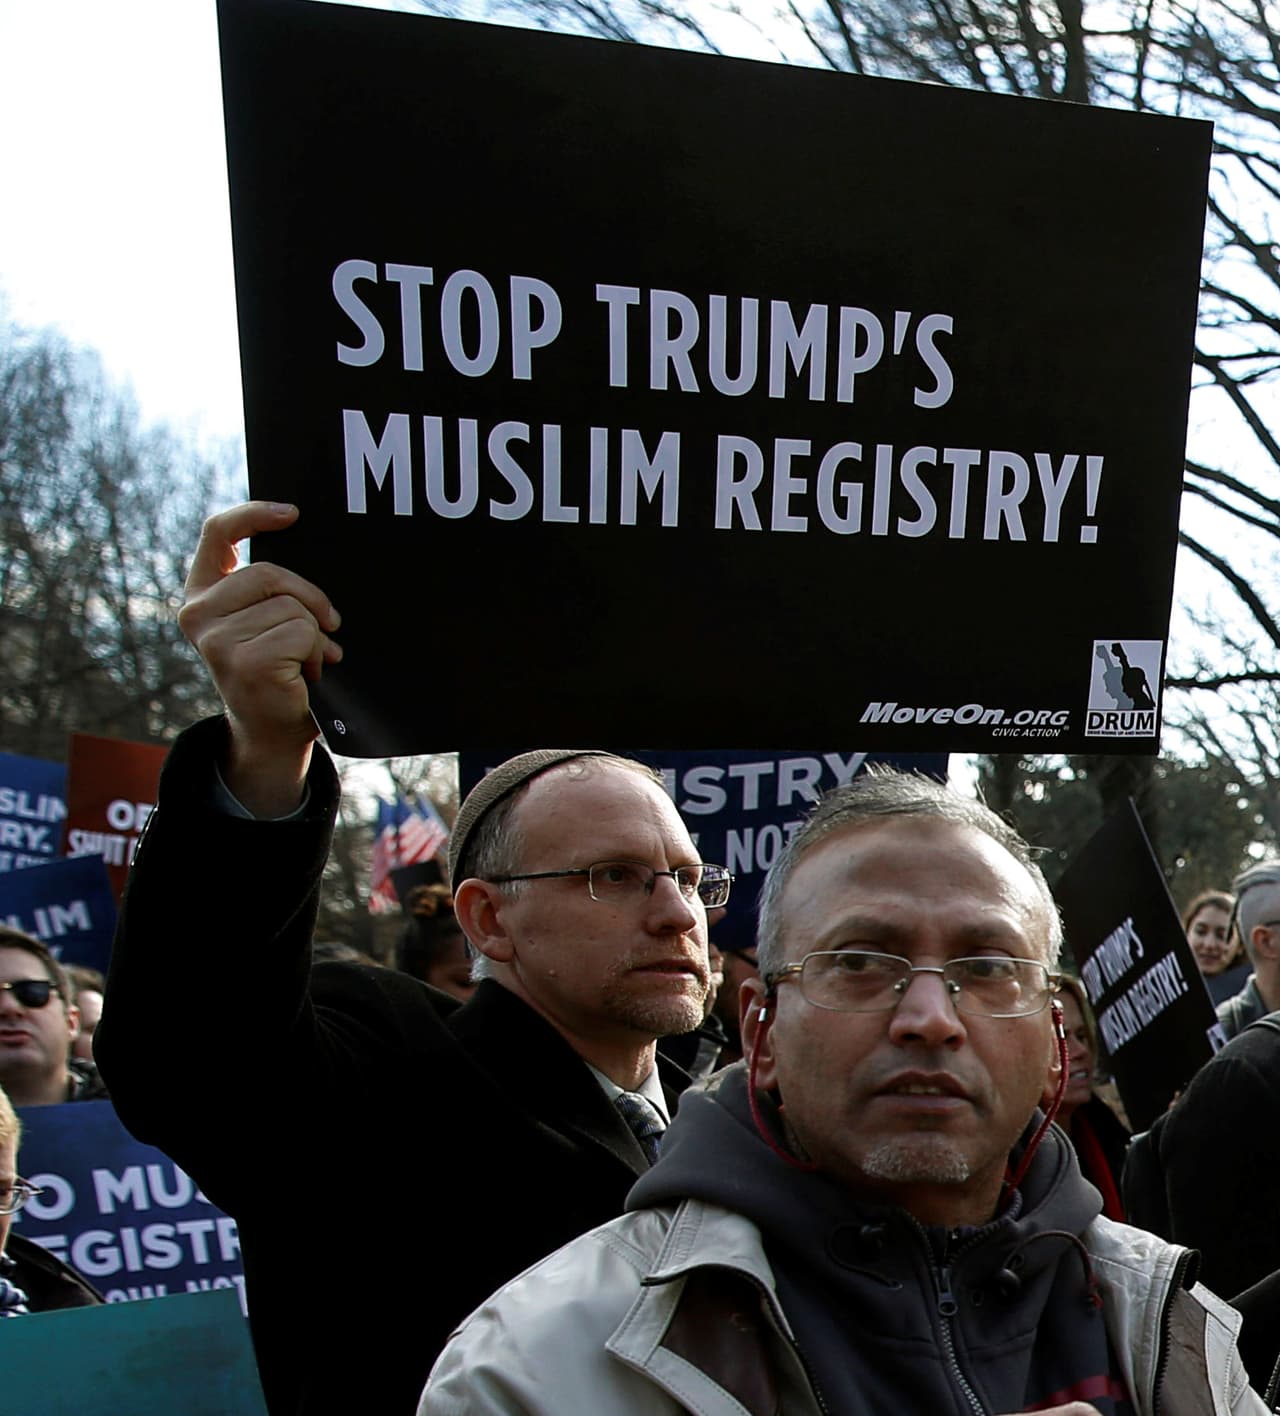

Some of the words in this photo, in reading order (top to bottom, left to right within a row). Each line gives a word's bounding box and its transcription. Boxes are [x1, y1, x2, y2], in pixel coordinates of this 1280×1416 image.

[331, 258, 563, 381] STOP
[595, 283, 954, 409] TRUMP'S
[342, 408, 681, 528] MUSLIM
[714, 434, 1105, 543] REGISTRY!
[859, 701, 1070, 726] MoveOn.ORG
[991, 727, 1021, 737] CIVIC
[1021, 728, 1061, 737] ACTION
[1088, 711, 1154, 731] DRUM
[92, 1163, 211, 1215] MU
